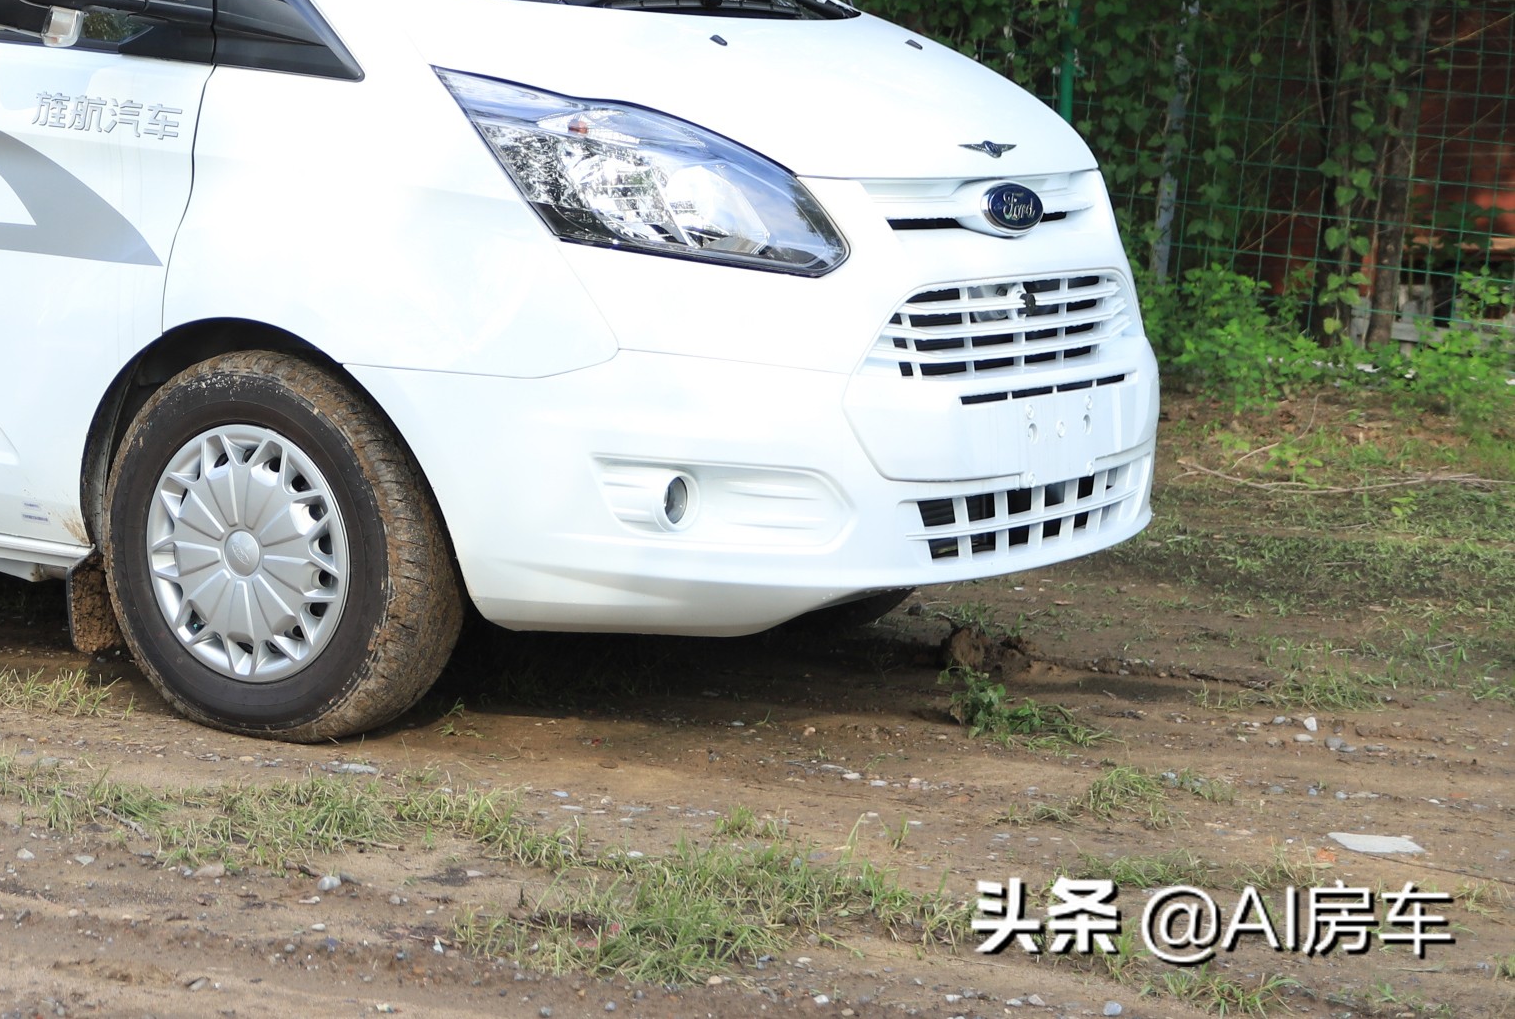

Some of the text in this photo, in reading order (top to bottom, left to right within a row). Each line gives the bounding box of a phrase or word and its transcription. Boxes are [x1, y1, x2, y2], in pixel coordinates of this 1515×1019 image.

[31, 90, 183, 140] 旌航汽车
[1003, 192, 1036, 220] Ford
